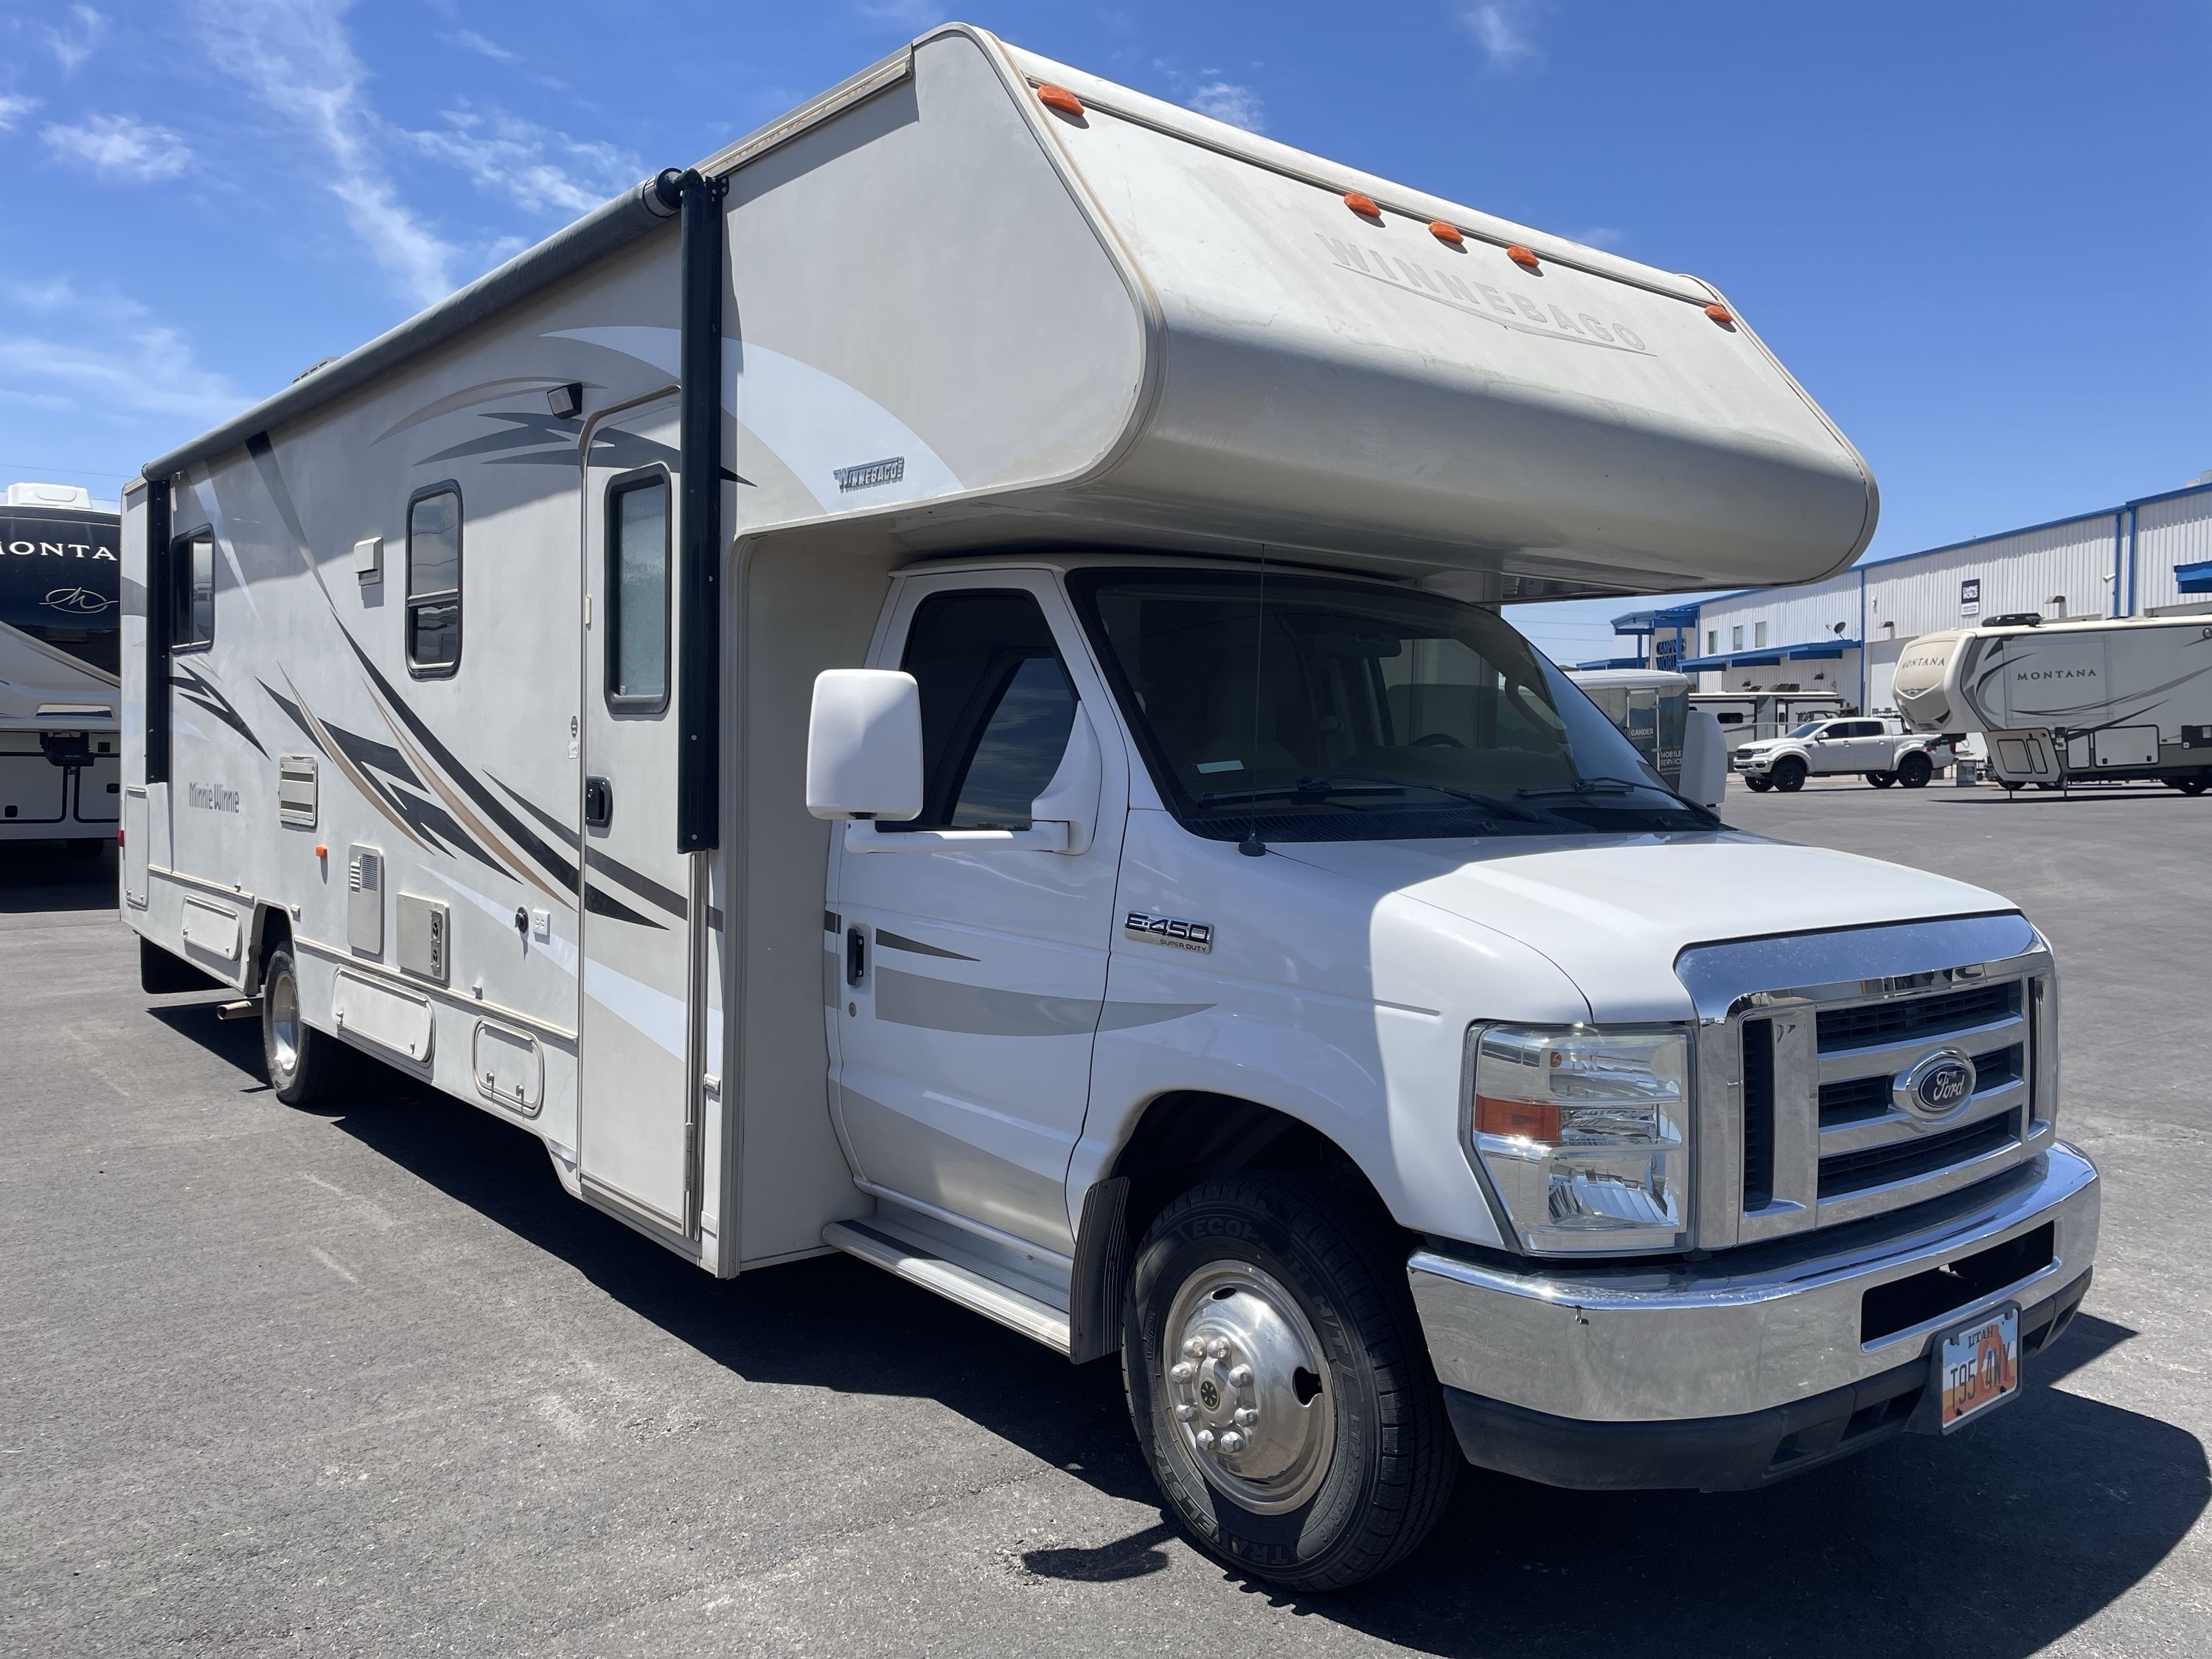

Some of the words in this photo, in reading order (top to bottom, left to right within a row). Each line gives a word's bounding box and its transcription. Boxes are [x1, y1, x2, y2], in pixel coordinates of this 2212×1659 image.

[1315, 232, 1646, 351] WINNEBAGO
[833, 461, 898, 490] WINNEBAGO
[0, 540, 118, 561] ONTA
[1656, 639, 1684, 655] CAMPIN
[1656, 655, 1684, 671] WORL
[1902, 657, 1945, 669] MONTANA
[2017, 668, 2097, 681] MONTANA
[1630, 728, 1654, 737] GANDER
[1660, 750, 1682, 759] MOBILE
[189, 782, 213, 810] Minnie
[214, 783, 240, 813] Winnie
[1160, 939, 1185, 949] SUPER
[1186, 945, 1207, 953] DUTY
[1933, 1070, 1966, 1102] Ford
[1968, 1326, 1994, 1349] UTAH
[1950, 1358, 1976, 1411] T95
